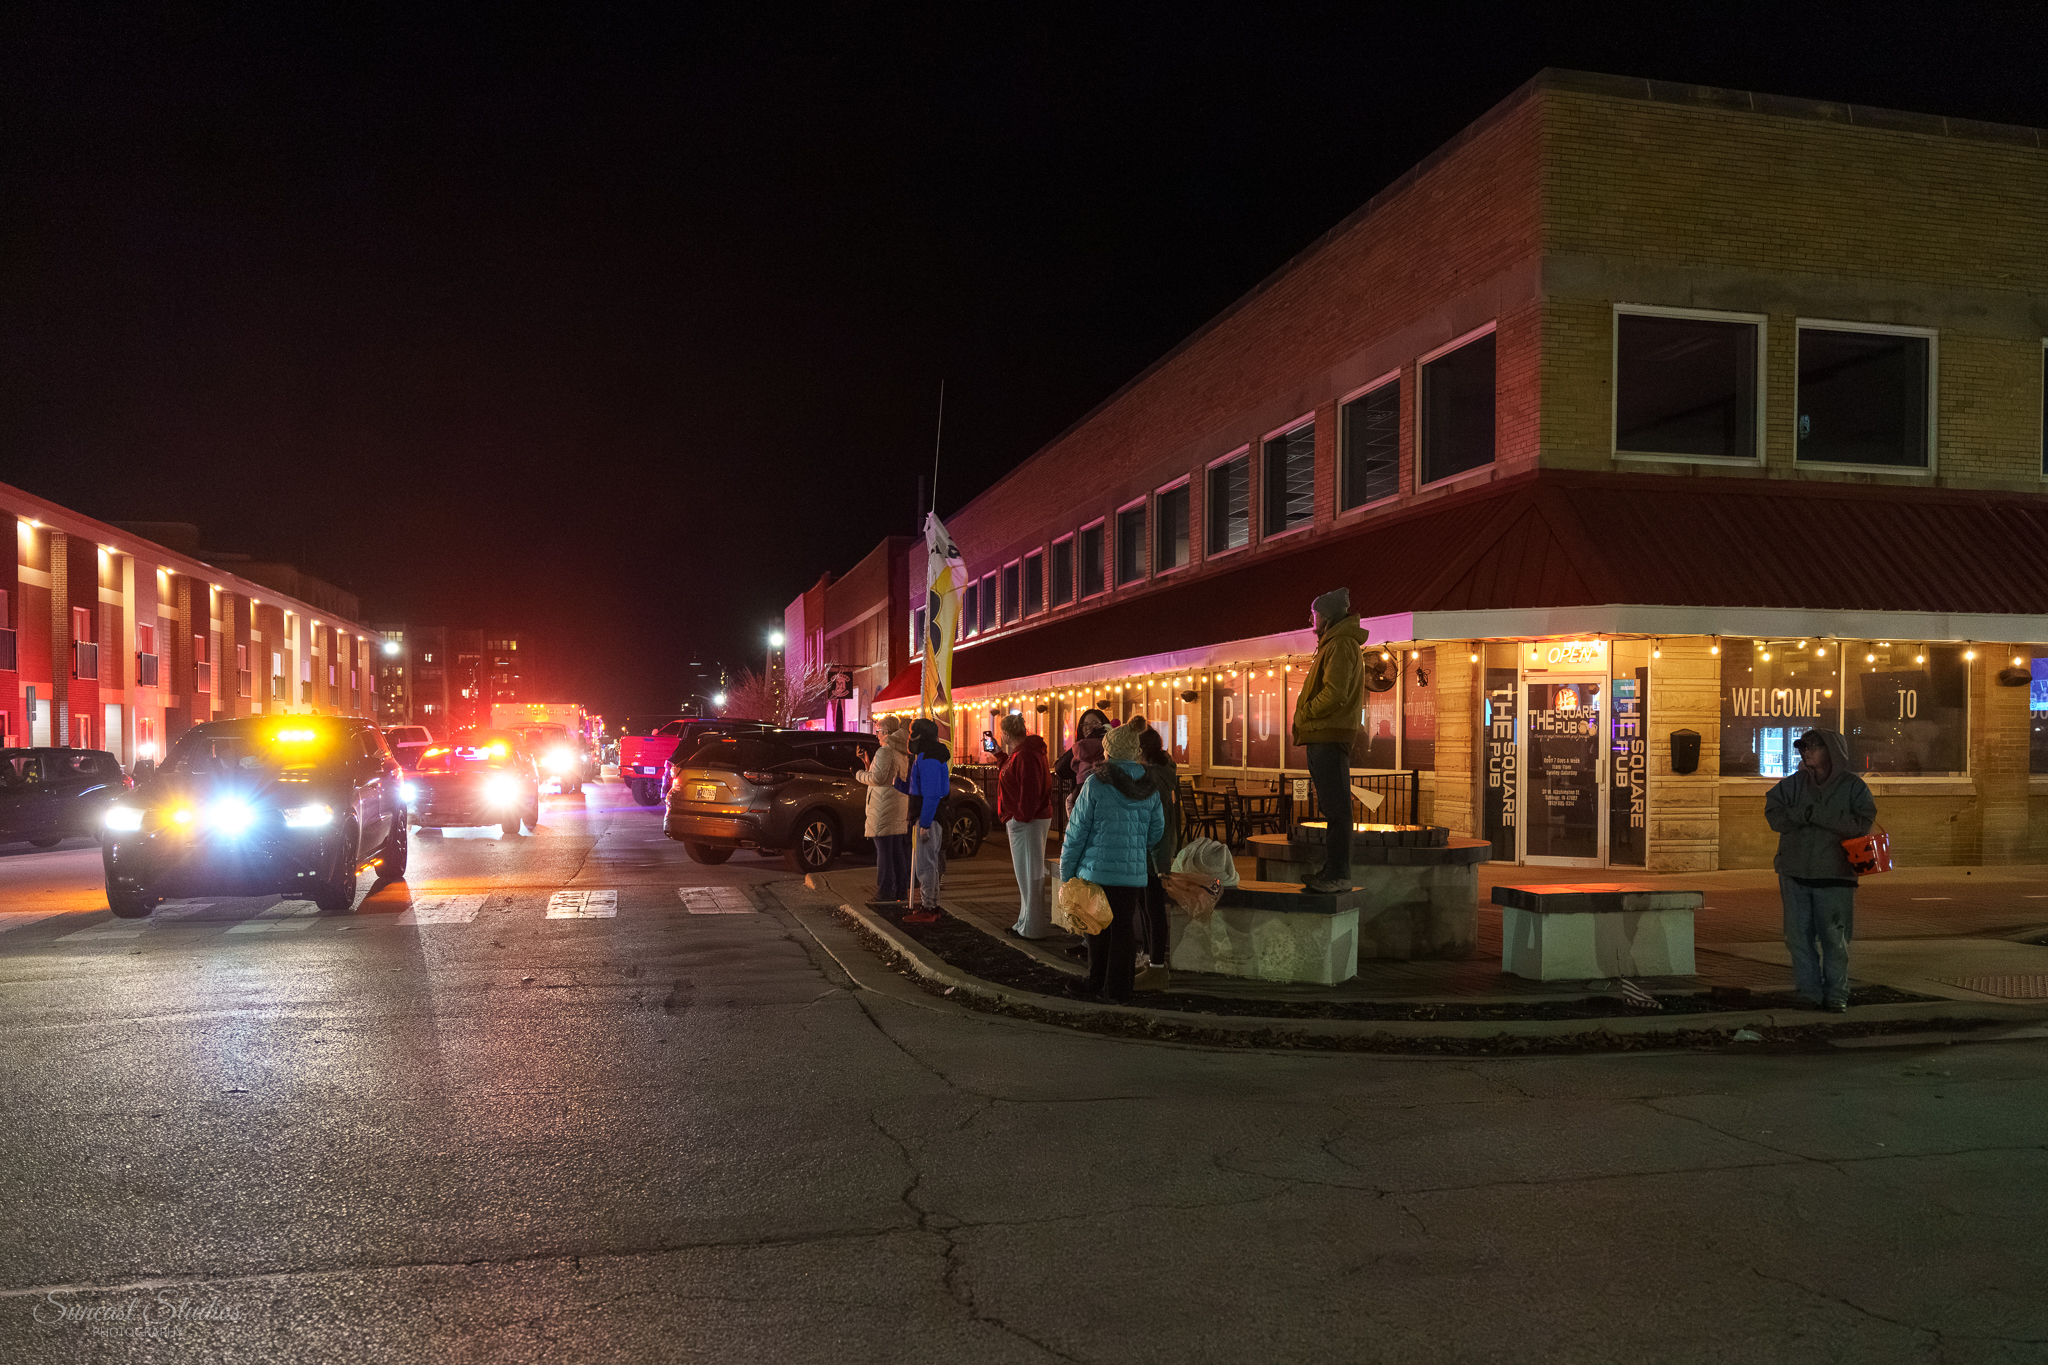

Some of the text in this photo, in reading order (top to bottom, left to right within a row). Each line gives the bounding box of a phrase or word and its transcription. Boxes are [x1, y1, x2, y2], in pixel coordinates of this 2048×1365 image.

[1547, 647, 1594, 664] OPEN
[1493, 683, 1513, 740] THE
[1528, 709, 1555, 731] THE
[1555, 705, 1596, 720] SQUARE
[1619, 678, 1641, 738] THE
[1731, 687, 1918, 719] WELCOME TO
[1555, 721, 1578, 735] PUB
[1489, 742, 1501, 788] PUB
[1502, 741, 1516, 827] SQUARE
[1615, 740, 1630, 789] PUB
[1630, 739, 1644, 828] SQUARE
